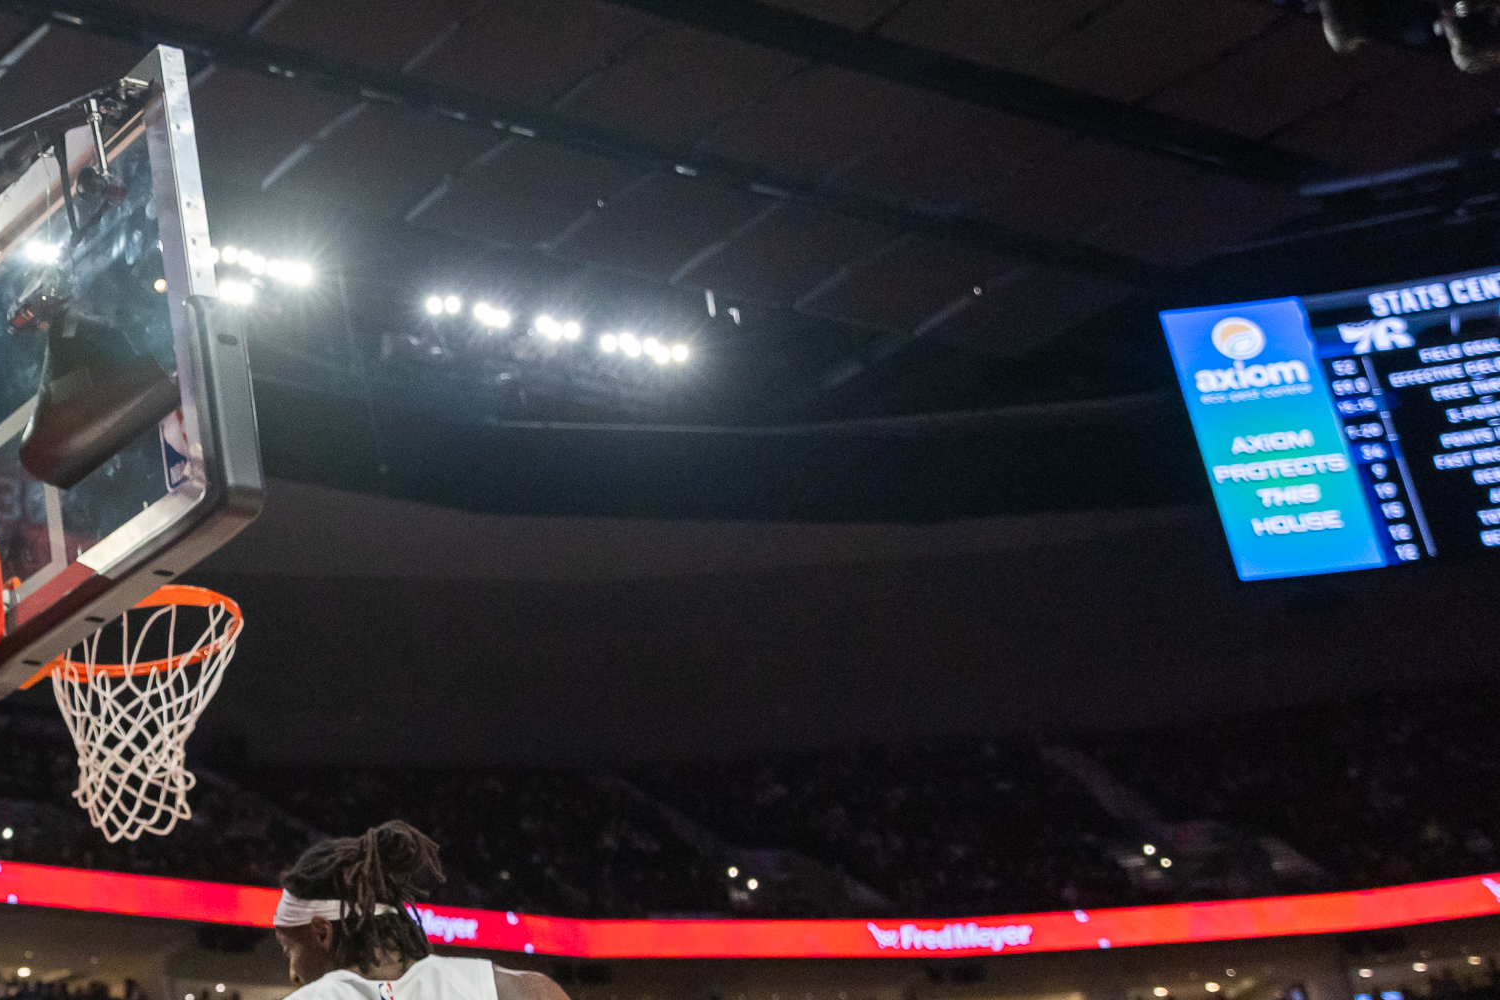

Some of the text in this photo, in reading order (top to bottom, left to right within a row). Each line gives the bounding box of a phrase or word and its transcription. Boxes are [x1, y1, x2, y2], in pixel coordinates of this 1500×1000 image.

[1368, 272, 1500, 317] STATS CEN
[1194, 359, 1310, 393] axiom
[1231, 428, 1315, 455] AXIOM
[1212, 453, 1349, 484] PROTECTS
[1256, 484, 1321, 507] THIS
[1251, 509, 1344, 536] HOUSE
